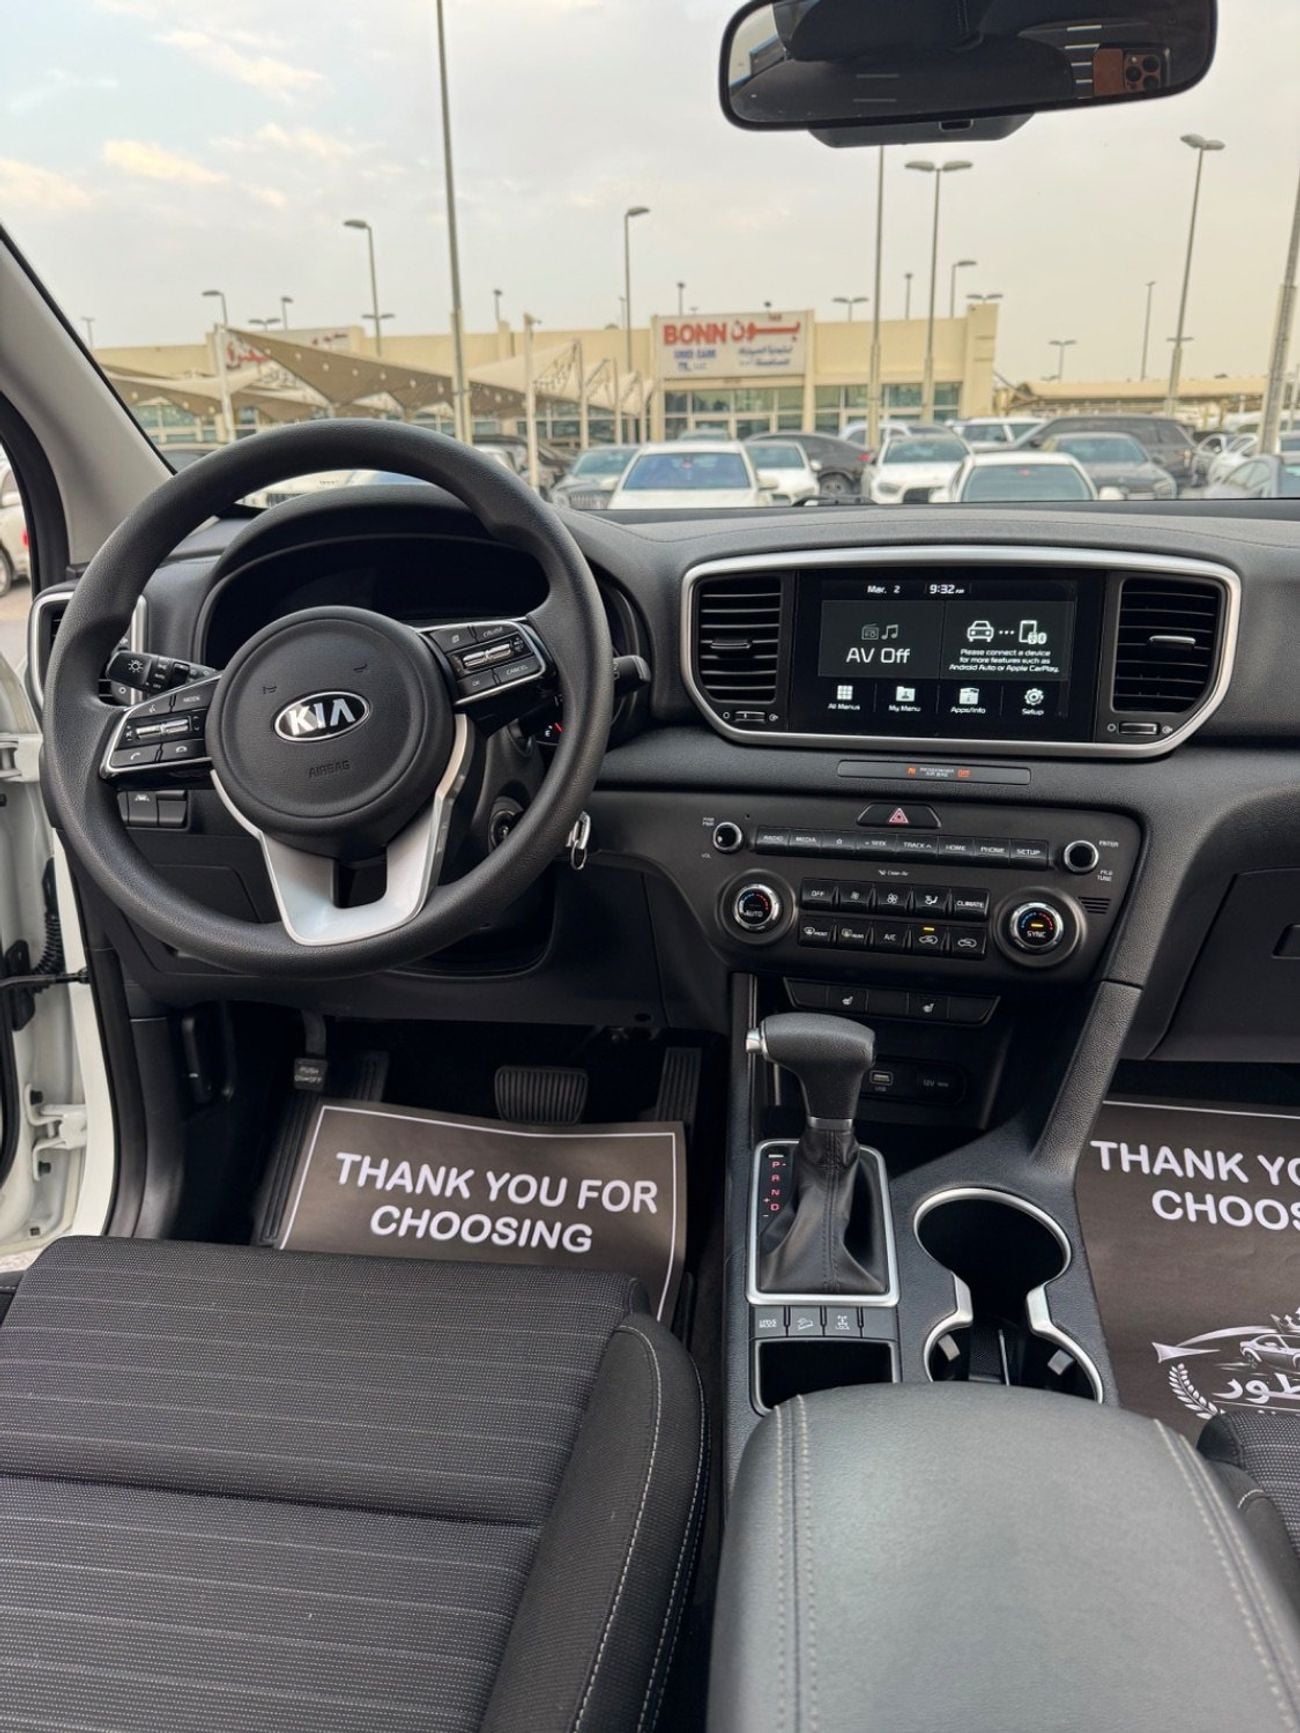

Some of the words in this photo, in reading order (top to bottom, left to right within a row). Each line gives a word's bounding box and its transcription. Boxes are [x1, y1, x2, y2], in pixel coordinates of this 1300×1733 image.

[664, 323, 727, 345] BONN
[867, 585, 887, 594] Mar.
[894, 585, 900, 594] 2
[846, 647, 875, 663] AV
[880, 648, 911, 663] Off
[960, 648, 985, 656] Please
[1029, 665, 1059, 673] CarPlay.
[1022, 708, 1044, 716] Setup
[288, 698, 356, 736] KIA
[308, 760, 351, 778] AIRBAG
[956, 900, 985, 908] CLIMATE
[884, 933, 896, 941] A/C
[1027, 930, 1047, 938] SYNC
[771, 1161, 780, 1169] P
[1089, 1140, 1249, 1184] THANK
[771, 1174, 780, 1182] R
[336, 1152, 475, 1199] THANK
[486, 1171, 568, 1207] YOU
[577, 1179, 658, 1214] FOR
[770, 1203, 780, 1211] D
[370, 1205, 593, 1253] CHOOSING
